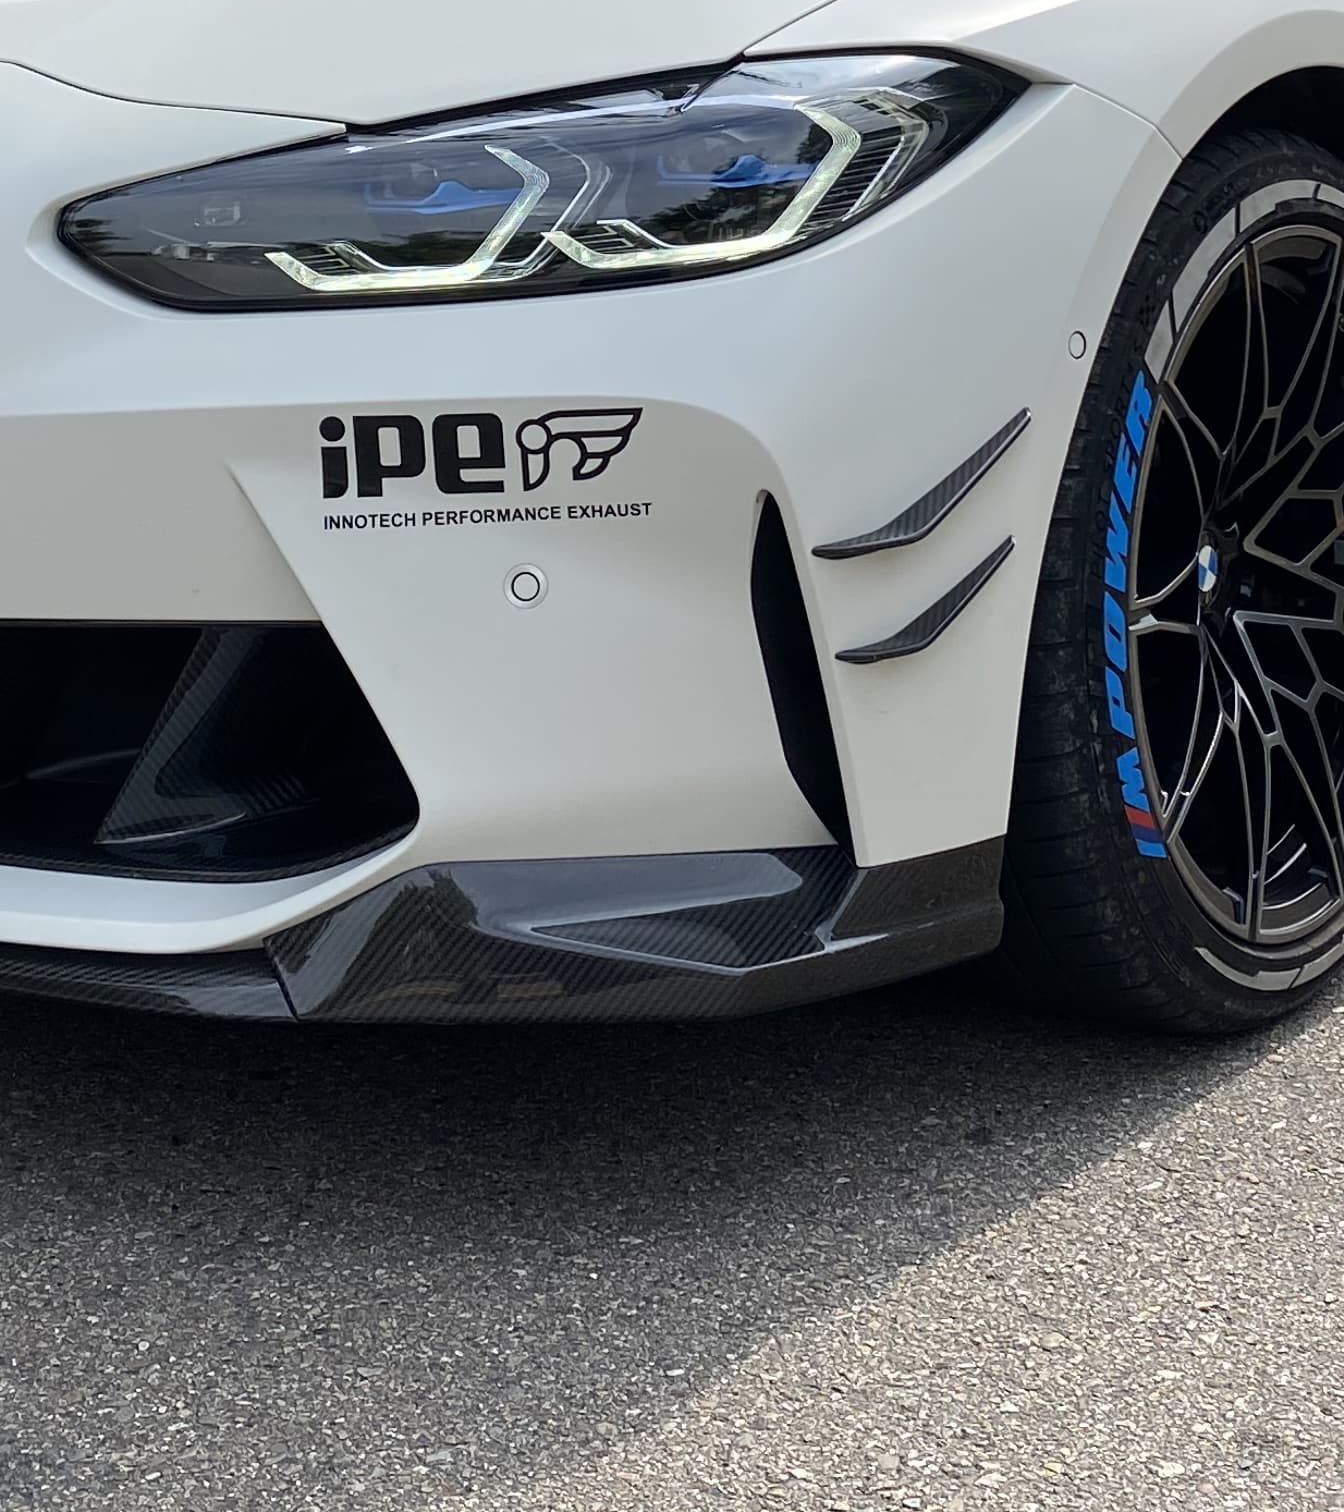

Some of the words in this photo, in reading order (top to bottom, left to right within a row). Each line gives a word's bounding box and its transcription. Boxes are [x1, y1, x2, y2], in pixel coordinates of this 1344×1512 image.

[322, 511, 417, 531] INNOTECH
[421, 506, 562, 527] PERFORMANCE
[566, 501, 654, 520] EXHAUST
[1103, 369, 1153, 740] POWER
